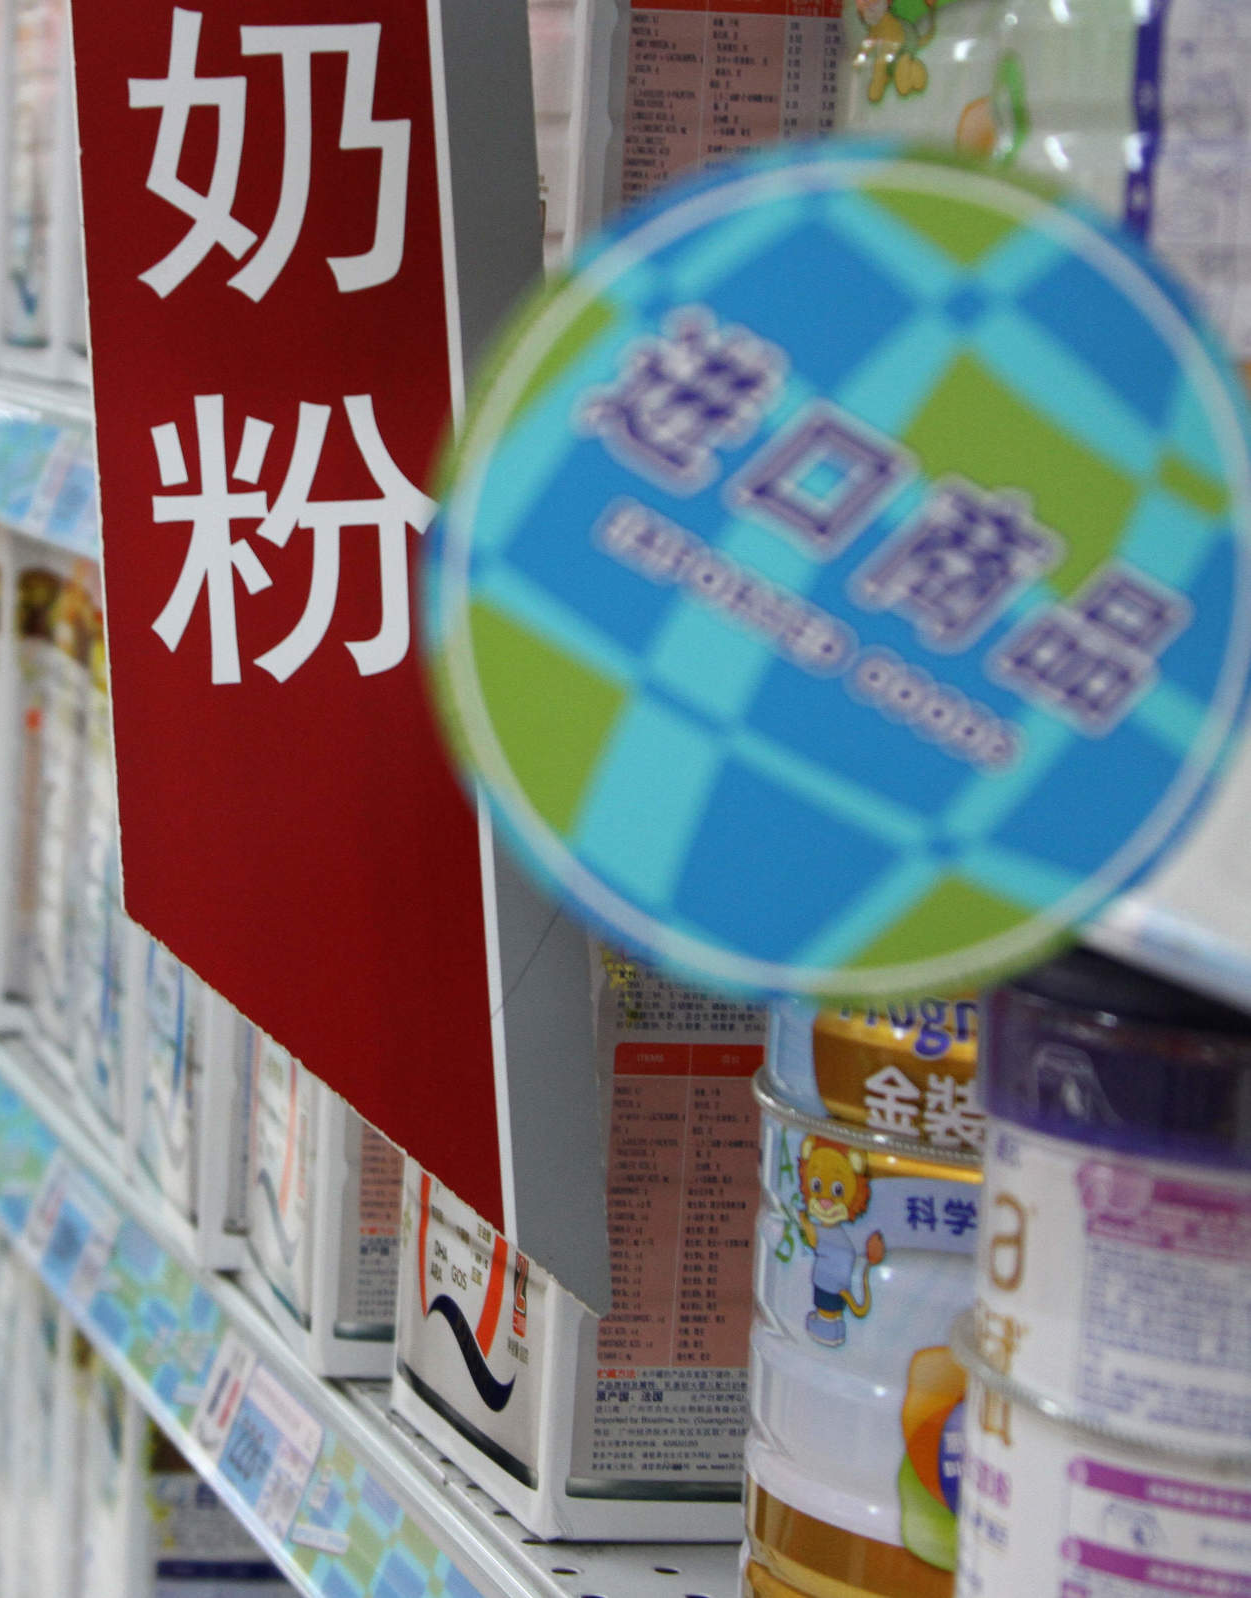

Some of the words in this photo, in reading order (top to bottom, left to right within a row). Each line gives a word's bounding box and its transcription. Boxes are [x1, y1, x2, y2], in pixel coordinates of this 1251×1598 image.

[128, 6, 440, 685] 奶粉
[577, 306, 1189, 736] 进口商品
[906, 1196, 978, 1236] 科学
[452, 1264, 467, 1291] GOS
[514, 1253, 528, 1315] 2
